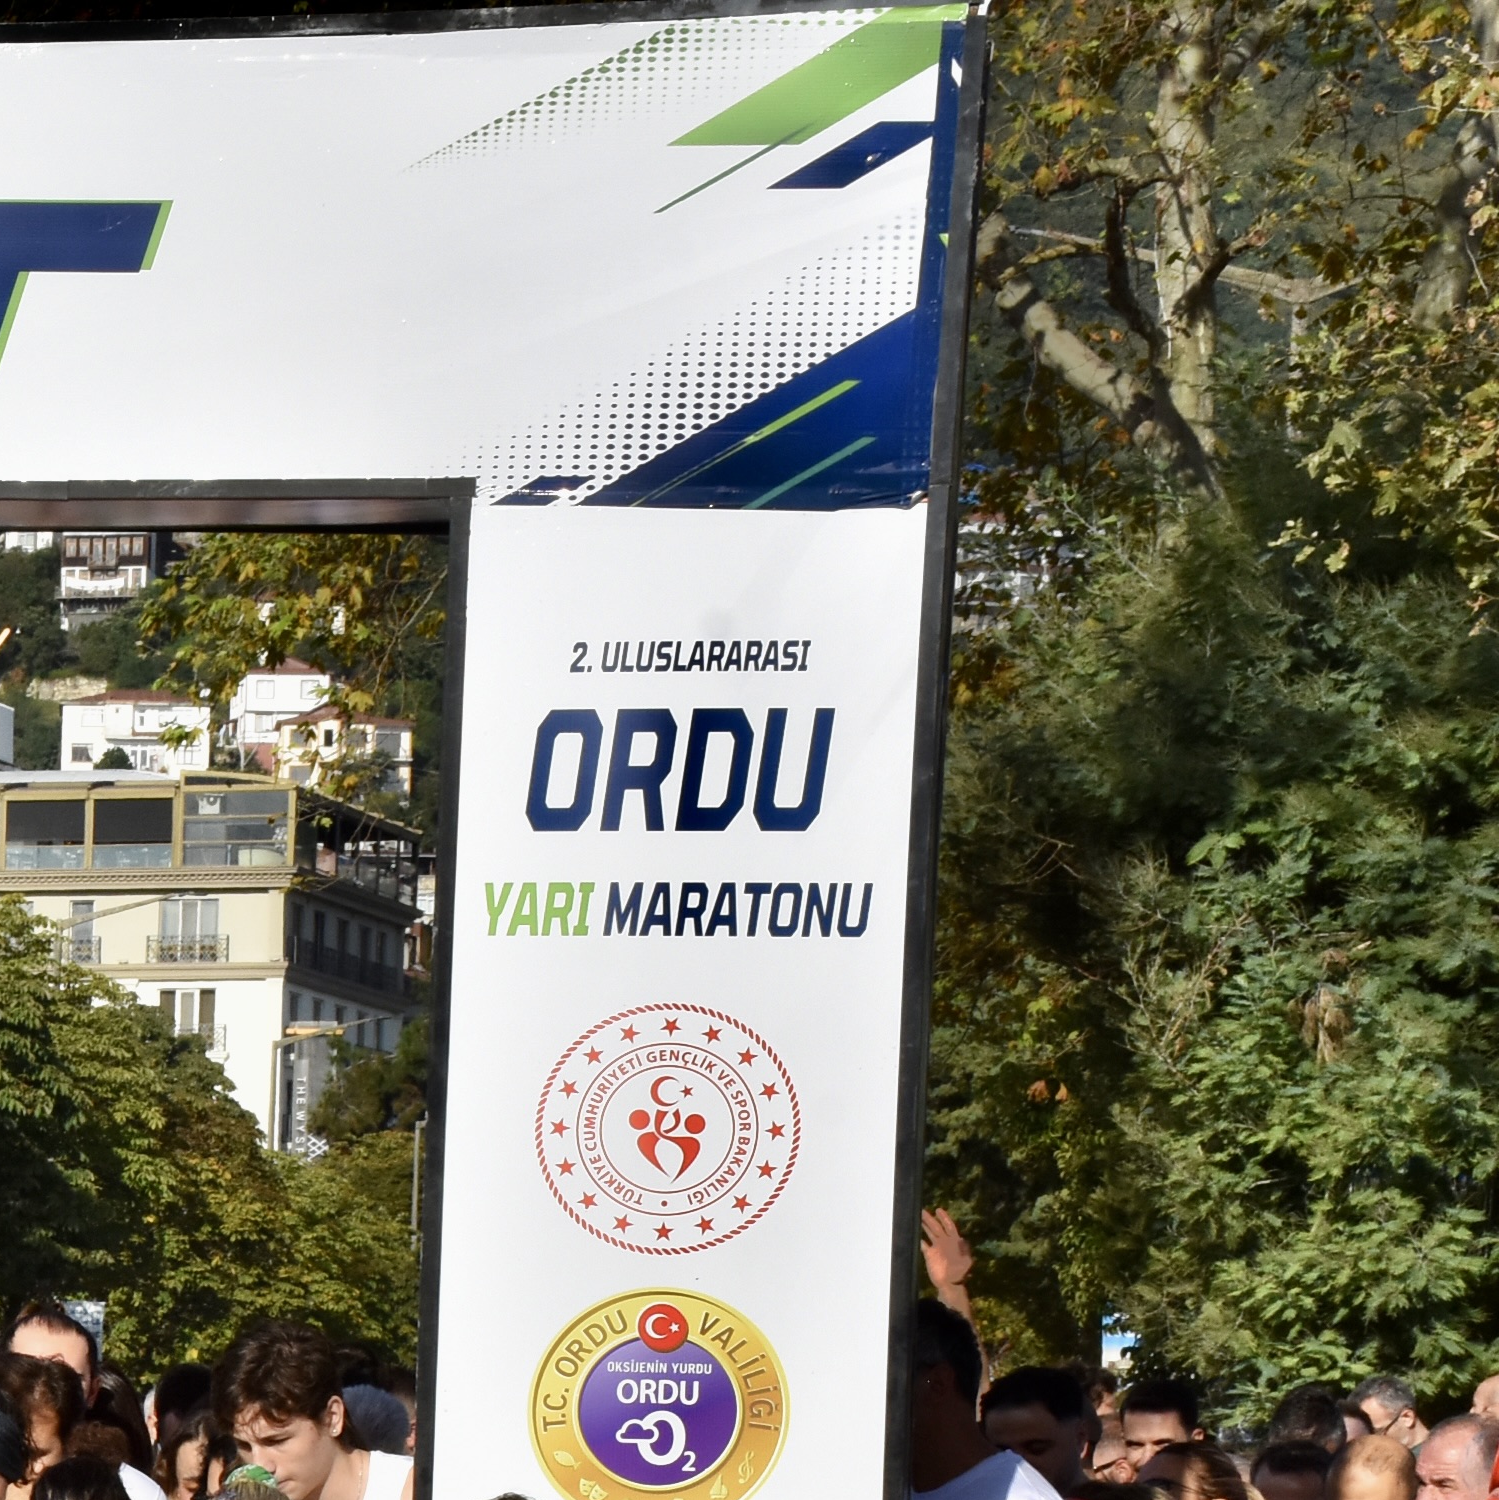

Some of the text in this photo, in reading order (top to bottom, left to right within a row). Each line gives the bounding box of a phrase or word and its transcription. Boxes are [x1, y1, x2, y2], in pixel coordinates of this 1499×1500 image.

[569, 640, 811, 674] 2. ULUSLARARASI
[525, 707, 836, 832] ORDU
[484, 882, 874, 938] YARI MARATONU
[584, 1050, 752, 1206] TÜRKİYE CUMHURİYETİ GENÇLİK VE SPOR BAKANLIĞI
[542, 1309, 629, 1433] T.C. ORDU
[606, 1358, 712, 1375] OKSİJENİN YURDU
[615, 1378, 700, 1406] ORDU
[699, 1311, 781, 1433] VALİLİĞİ
